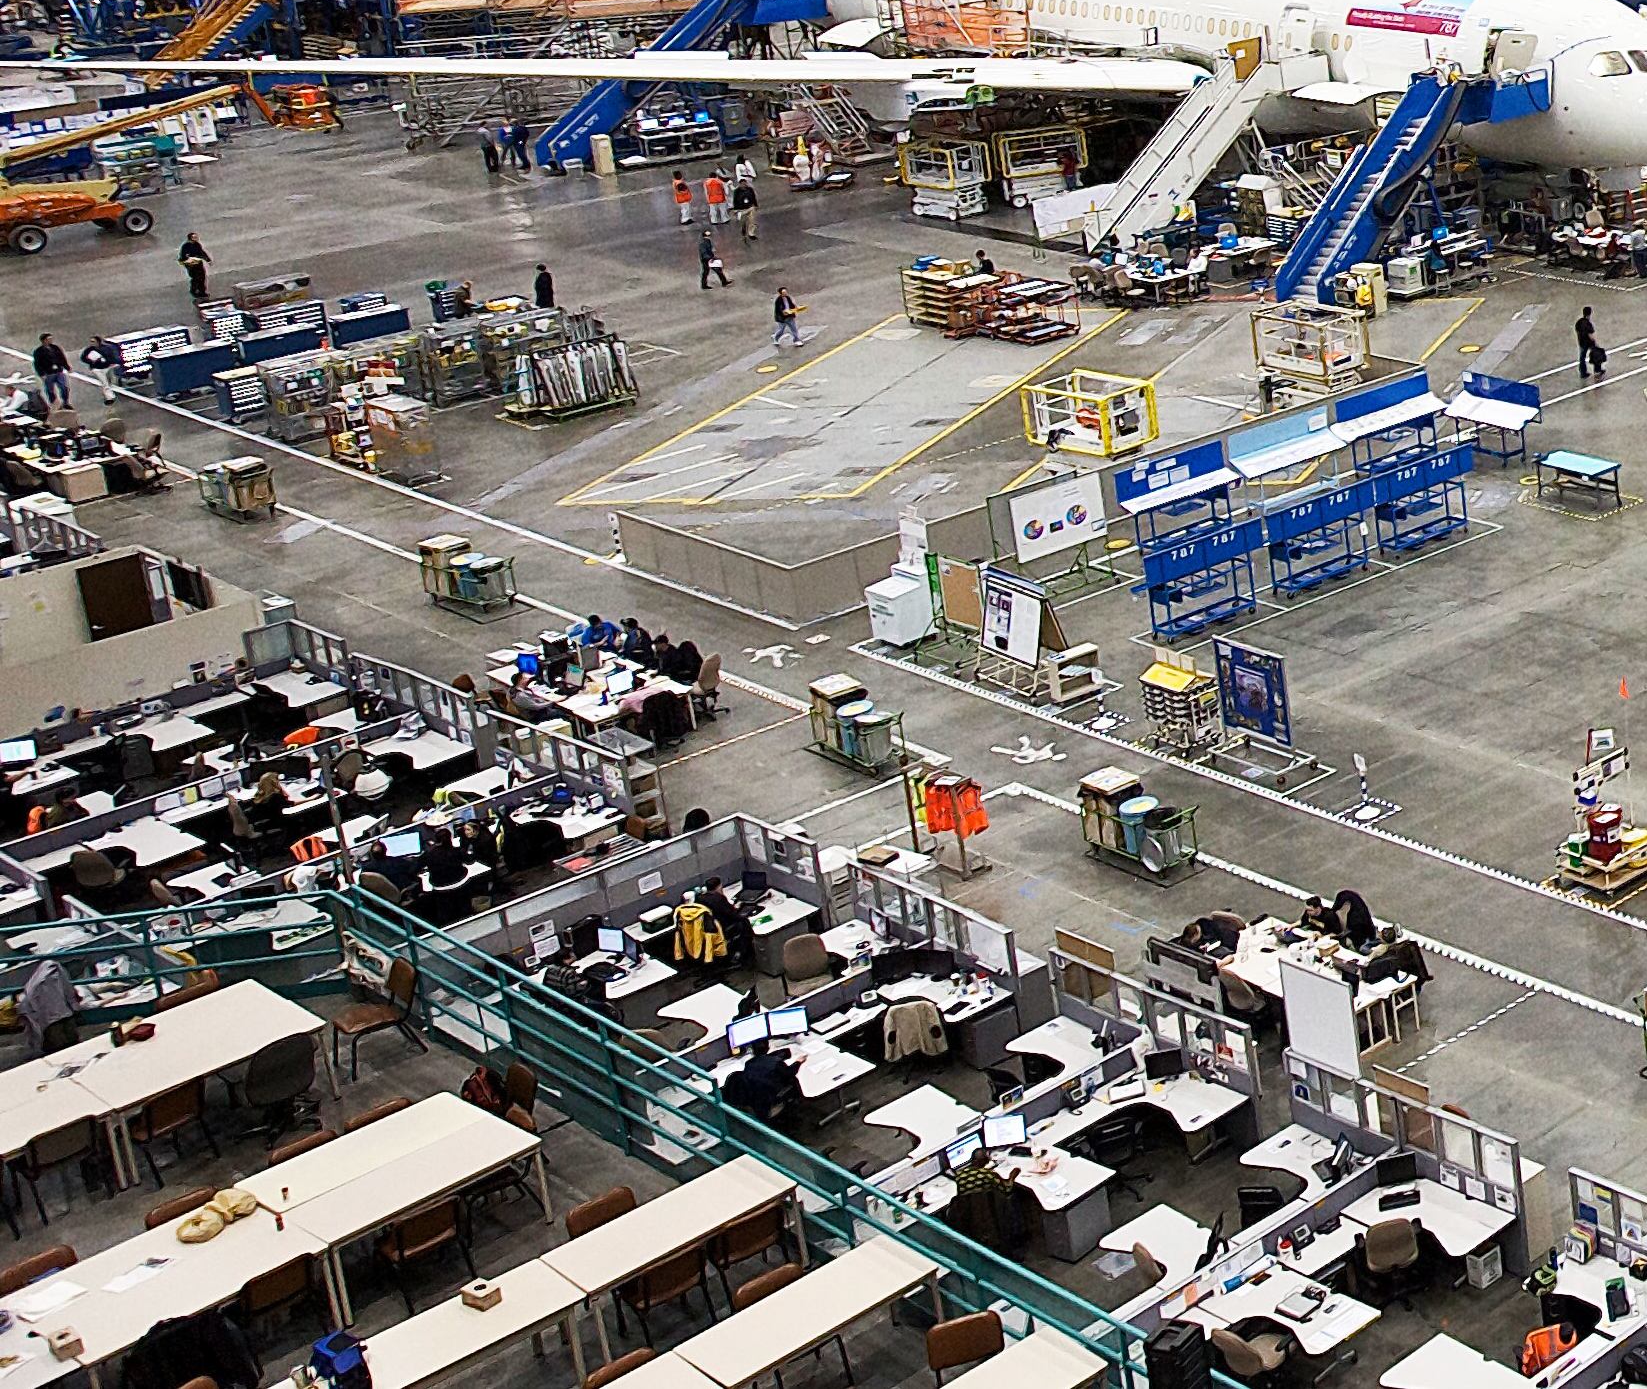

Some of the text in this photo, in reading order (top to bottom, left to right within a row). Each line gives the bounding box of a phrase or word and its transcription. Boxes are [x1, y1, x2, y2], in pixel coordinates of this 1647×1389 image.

[1438, 20, 1461, 35] 787
[1430, 454, 1451, 470] 787
[1396, 466, 1418, 482] 787
[1328, 491, 1350, 506] 787
[1290, 503, 1313, 520] 787
[1212, 530, 1236, 547] 787
[1171, 543, 1195, 562] 787
